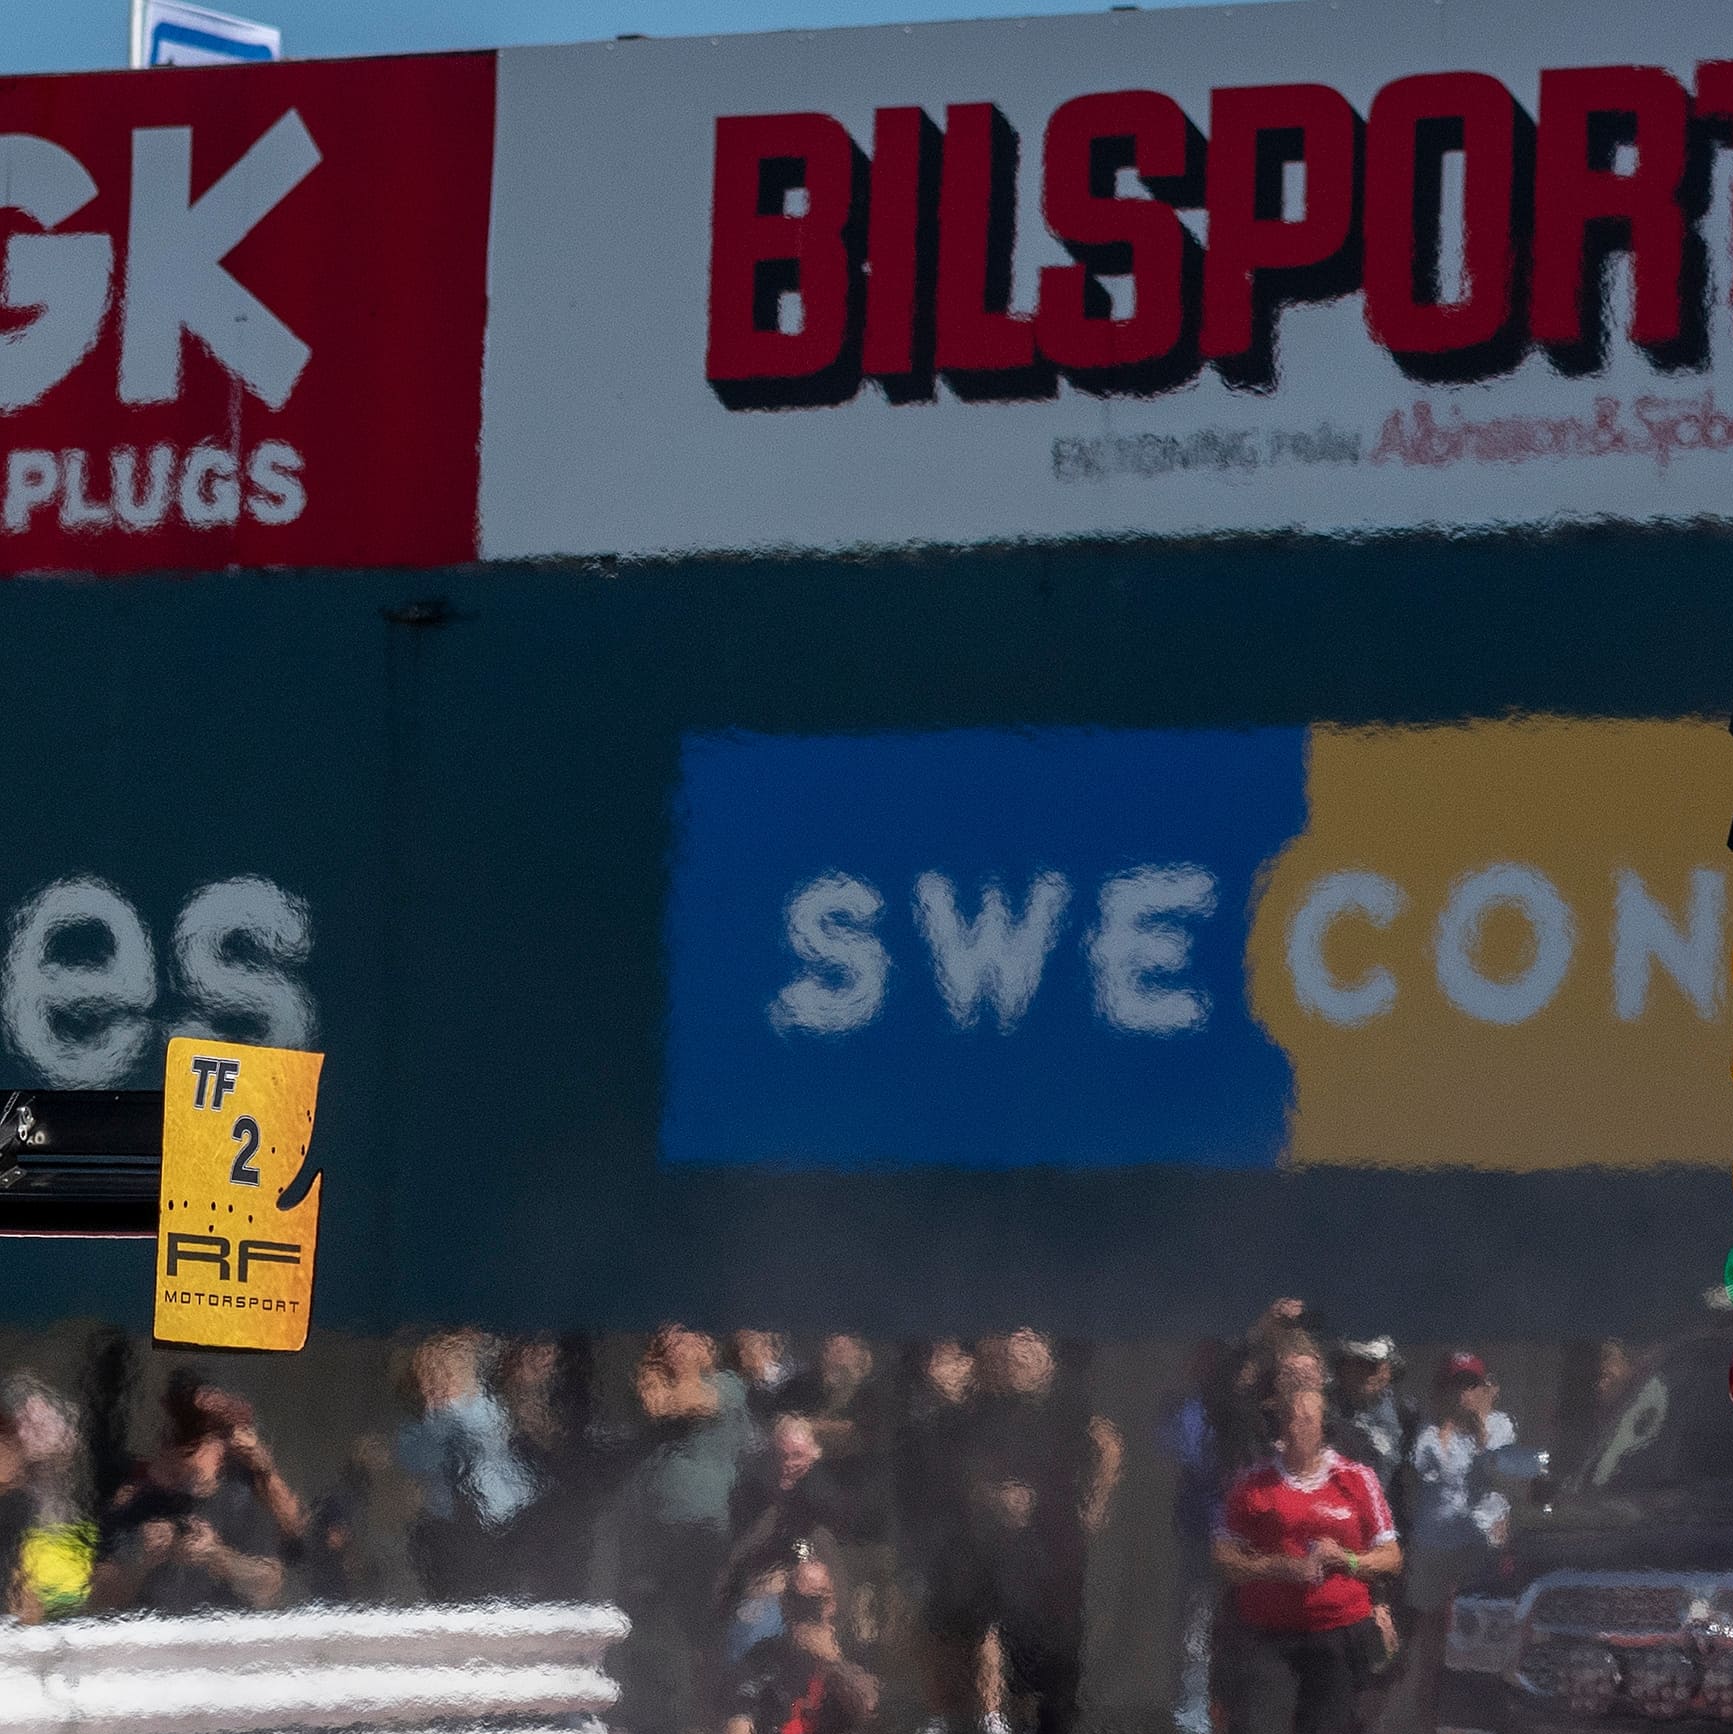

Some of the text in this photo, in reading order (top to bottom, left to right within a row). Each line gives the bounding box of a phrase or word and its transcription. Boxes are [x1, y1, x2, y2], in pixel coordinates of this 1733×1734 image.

[2, 438, 307, 533] PLUGS
[191, 1055, 241, 1112] TF
[229, 1114, 262, 1187] 2
[166, 1232, 301, 1283] RF
[164, 1290, 300, 1314] MOTORSPORT
